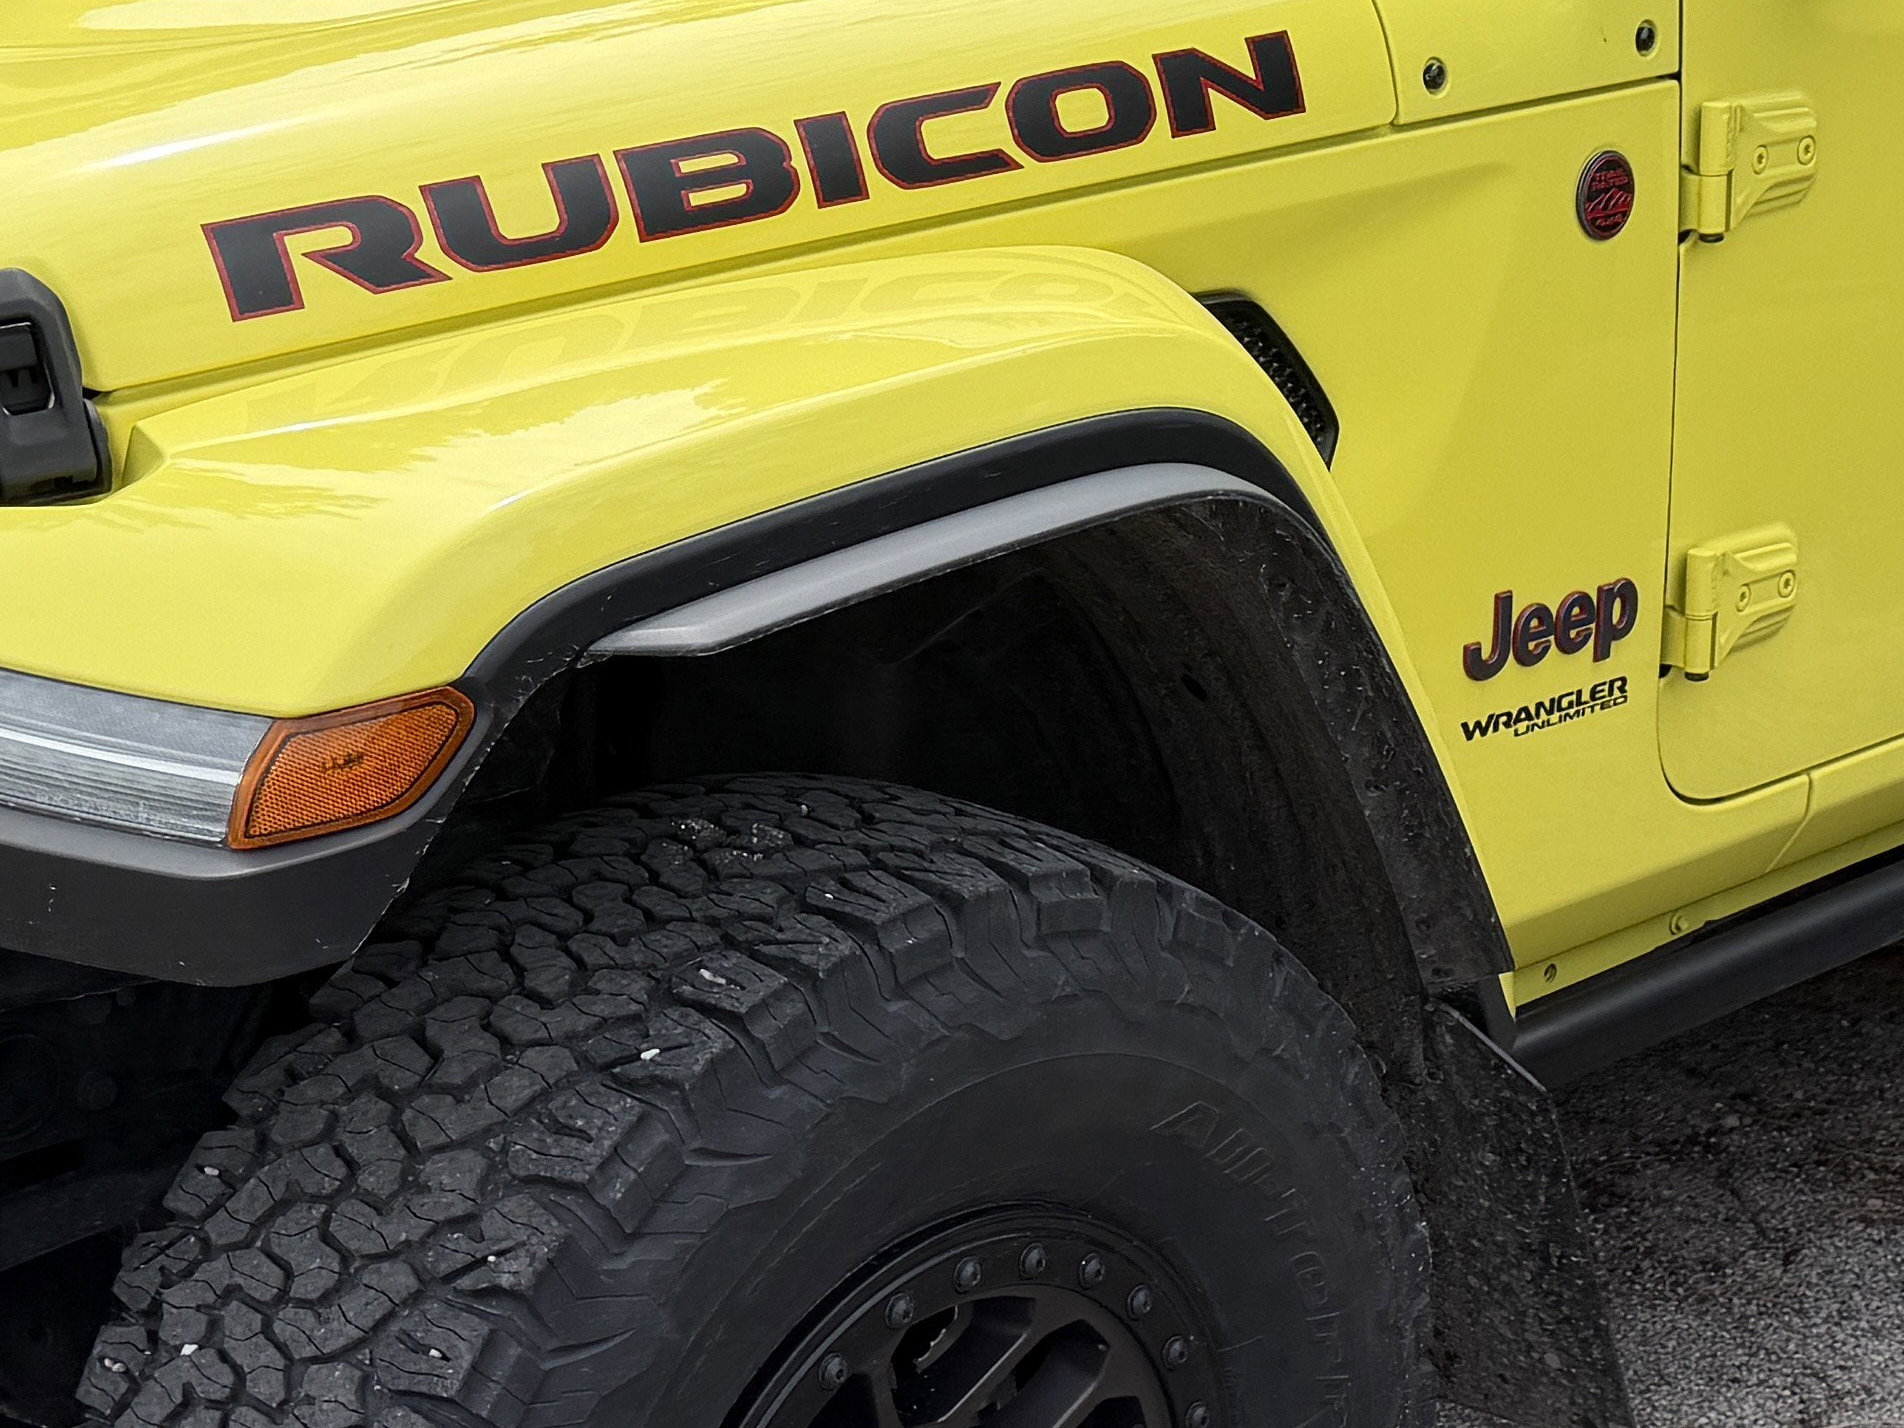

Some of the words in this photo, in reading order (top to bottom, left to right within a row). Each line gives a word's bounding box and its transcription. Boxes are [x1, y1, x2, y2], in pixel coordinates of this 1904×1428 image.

[201, 29, 1307, 323] RUBICON
[1462, 577, 1639, 682] Jeep
[1459, 675, 1629, 742] WRANGLER
[1513, 694, 1629, 738] UNLIMITED
